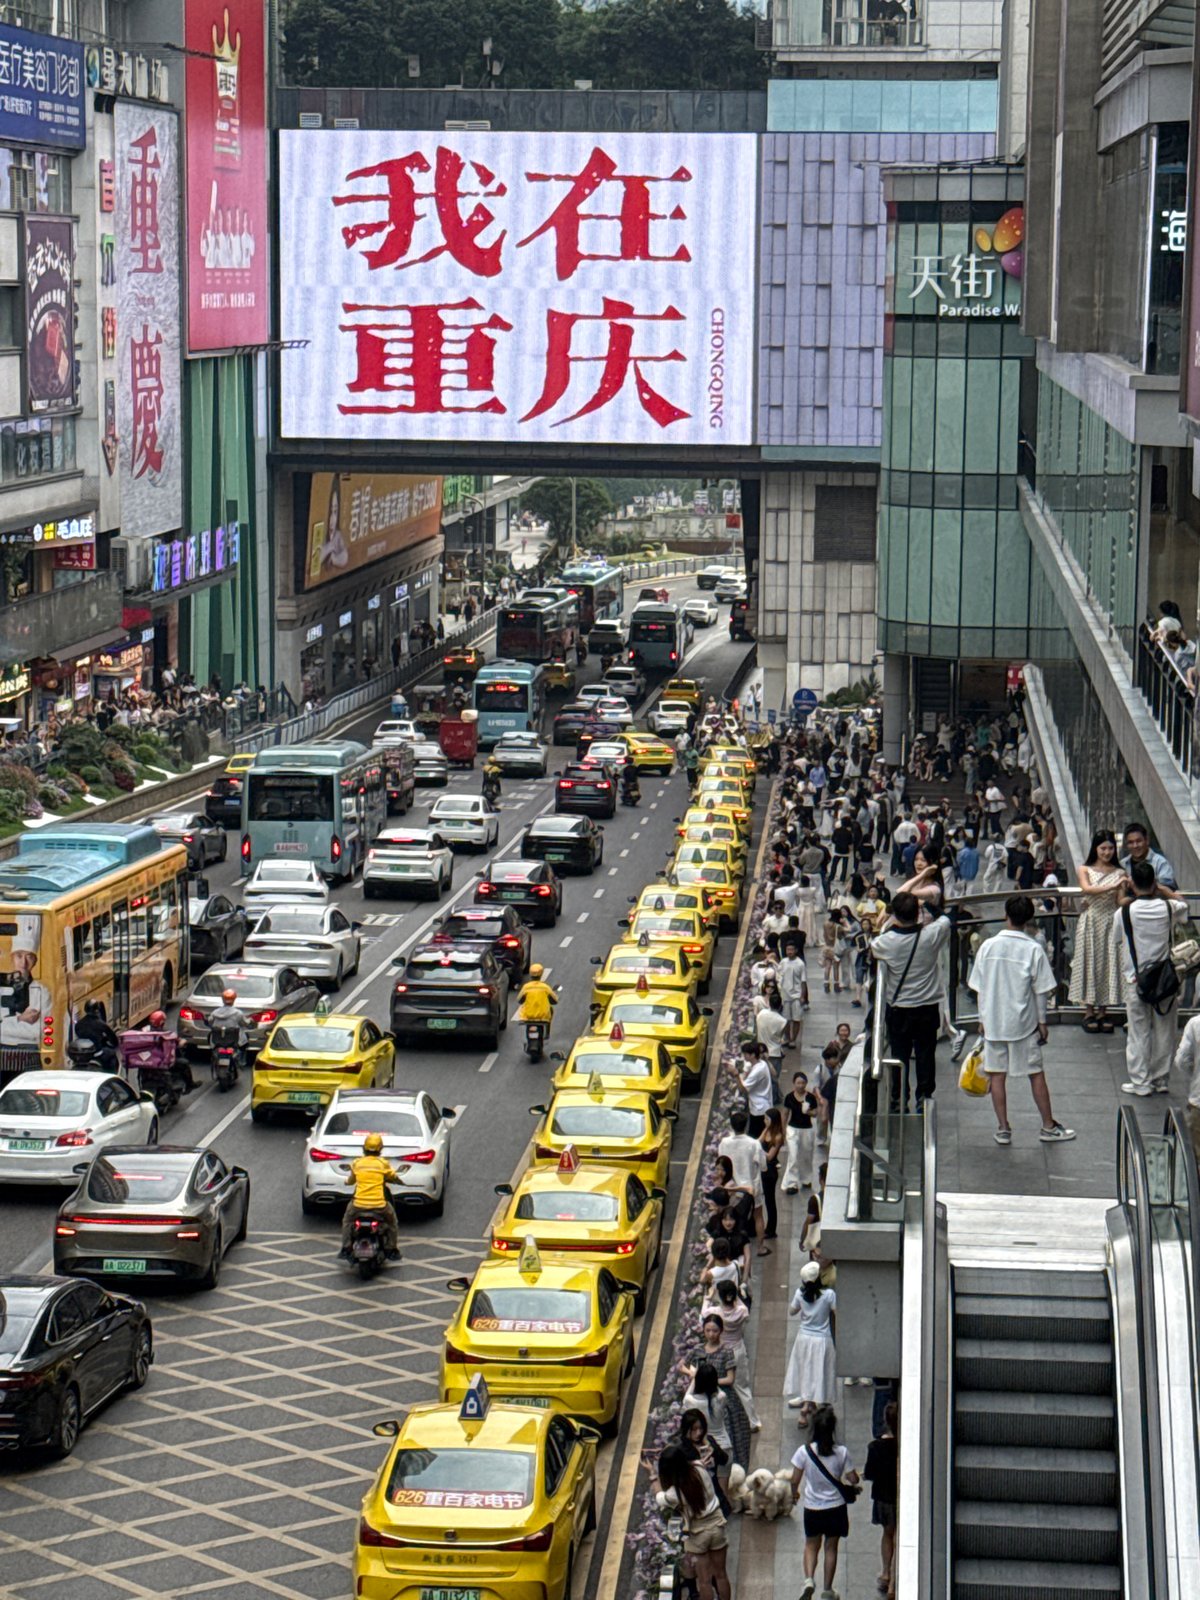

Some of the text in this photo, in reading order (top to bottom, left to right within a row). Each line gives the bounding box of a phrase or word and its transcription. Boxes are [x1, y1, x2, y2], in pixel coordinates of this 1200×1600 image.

[331, 145, 693, 281] 我在
[907, 253, 997, 300] 天街
[939, 303, 1000, 317] Paradise
[337, 296, 693, 429] 重庆
[708, 307, 725, 429] CHONGQING
[472, 1318, 582, 1333] 626重百家电节
[394, 1489, 524, 1508] 626重百家电节
